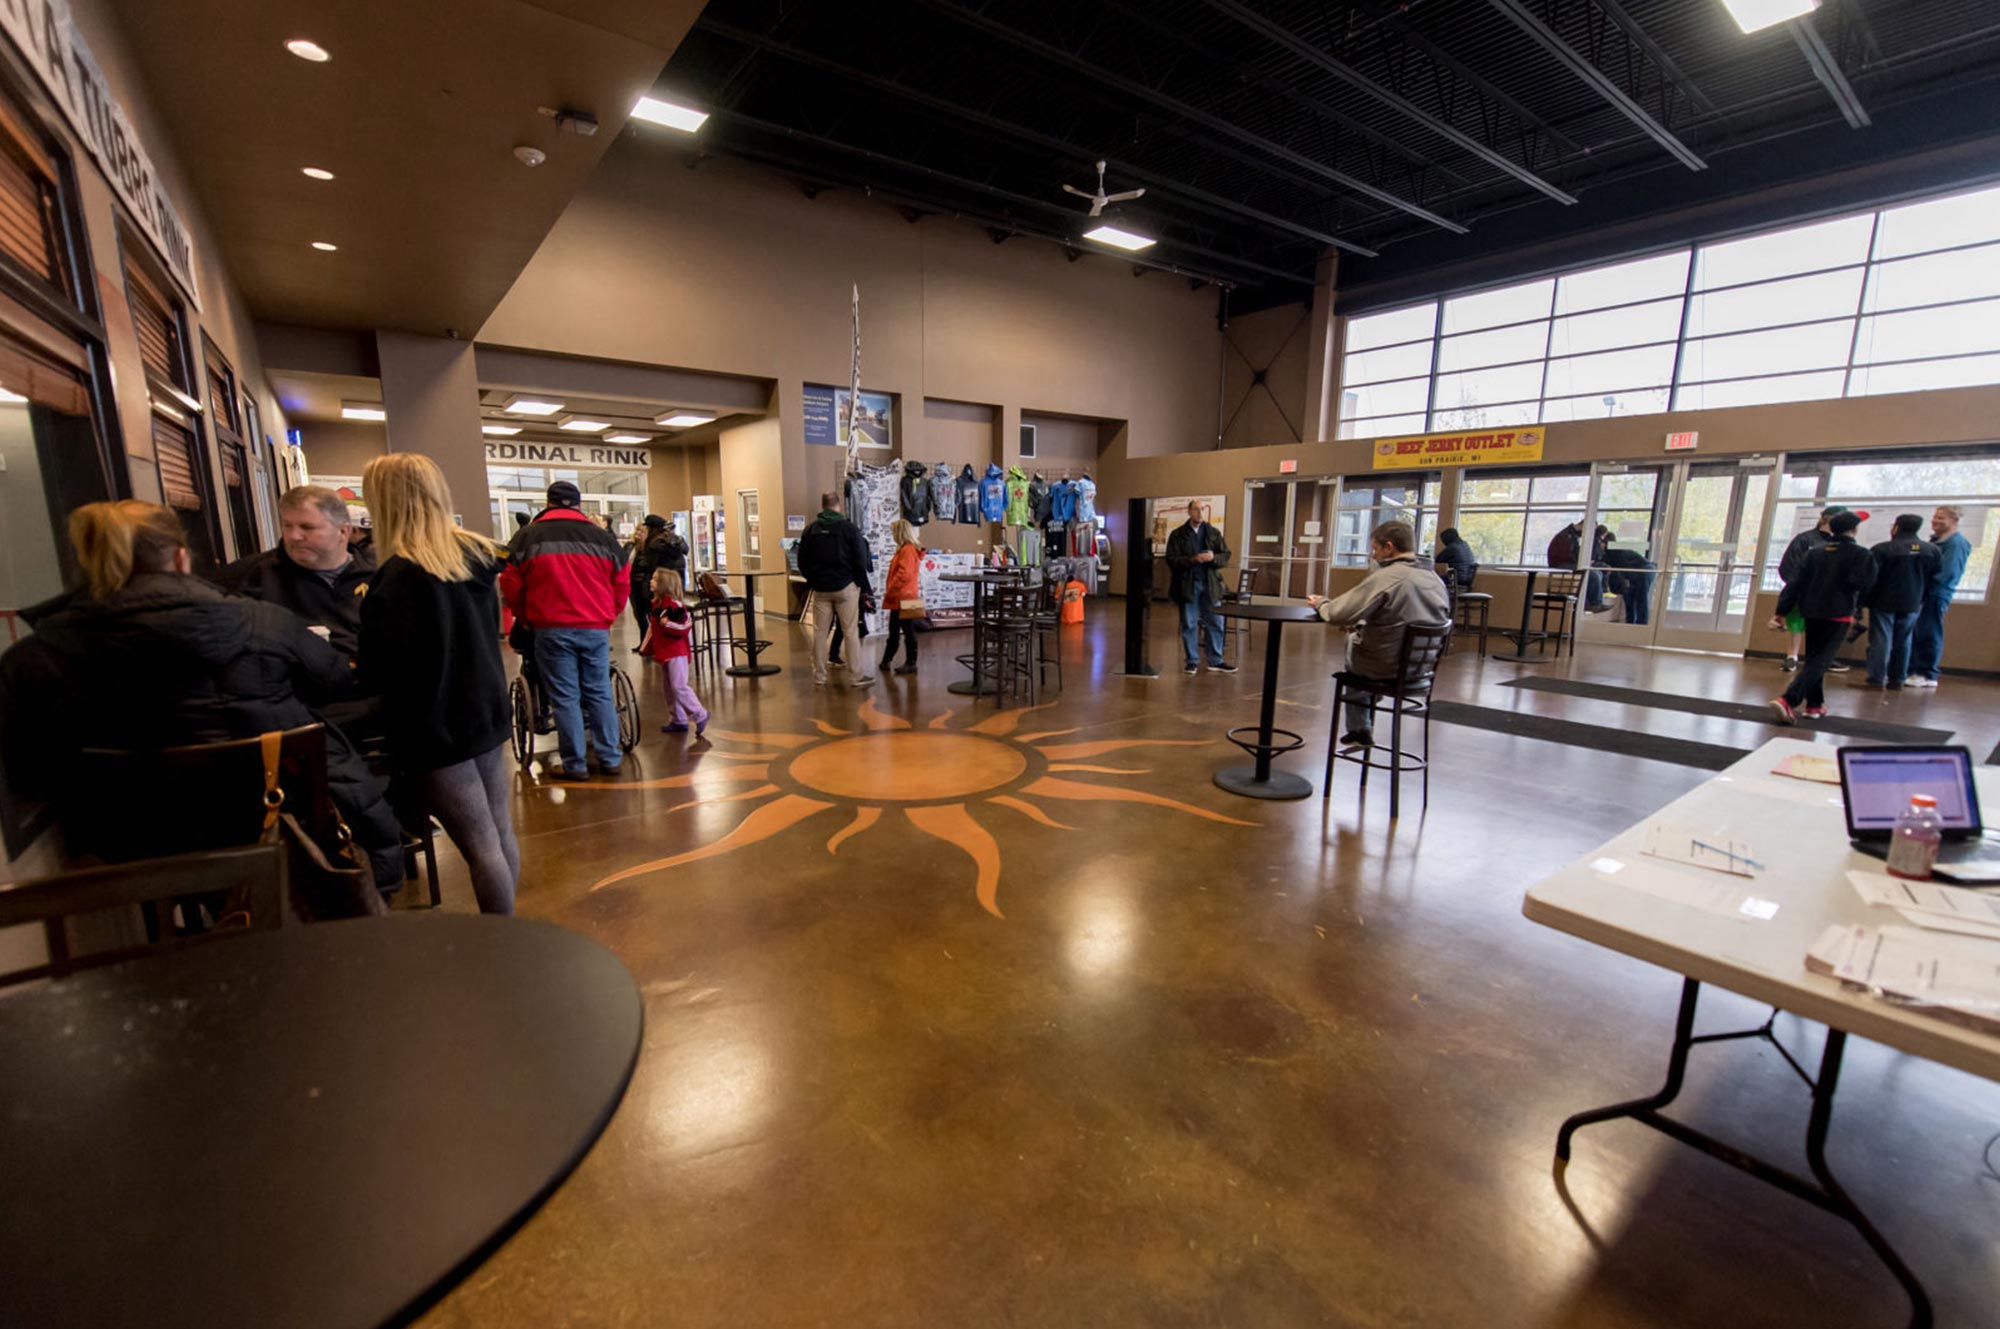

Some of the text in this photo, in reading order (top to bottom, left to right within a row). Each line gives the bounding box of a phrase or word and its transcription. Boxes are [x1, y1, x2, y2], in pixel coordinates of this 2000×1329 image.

[69, 41, 159, 238] TUBBS
[1396, 433, 1515, 455] BEEF JERKY OUTLET
[590, 449, 648, 466] RINK
